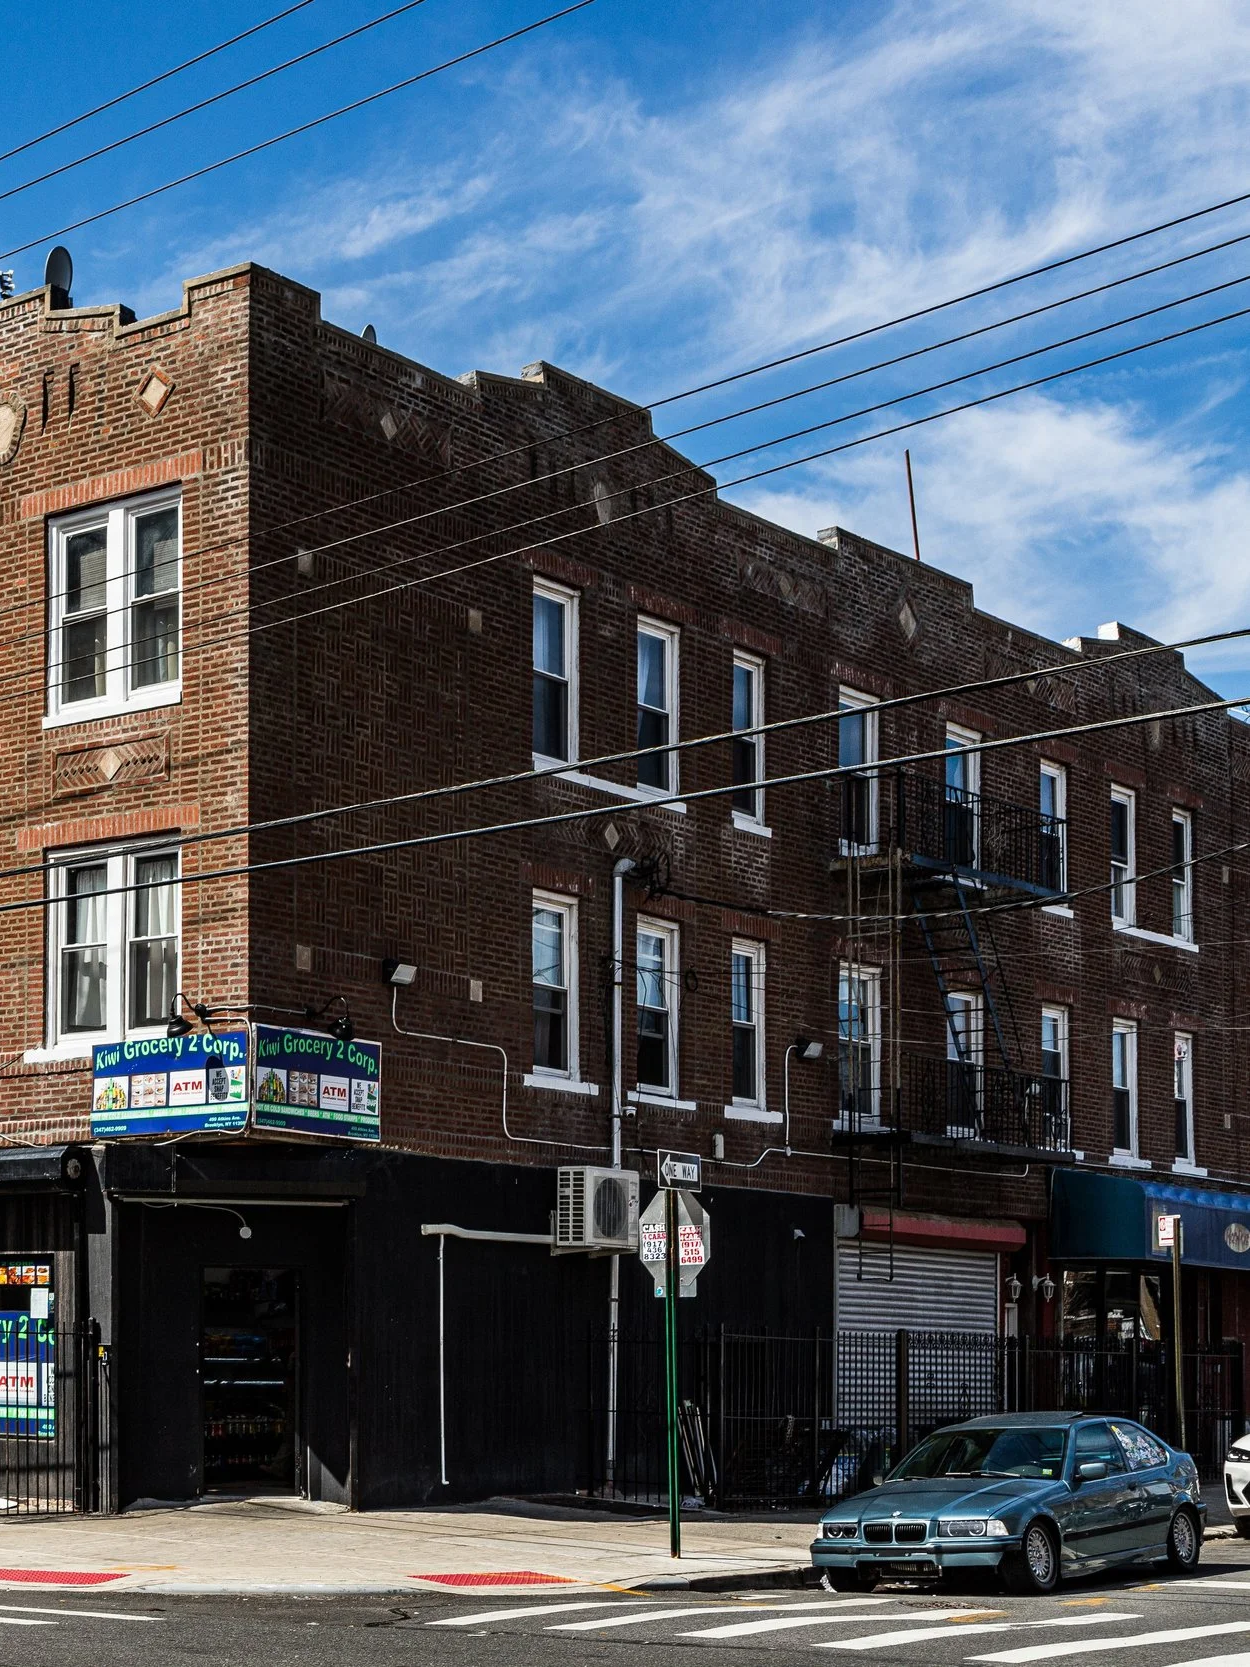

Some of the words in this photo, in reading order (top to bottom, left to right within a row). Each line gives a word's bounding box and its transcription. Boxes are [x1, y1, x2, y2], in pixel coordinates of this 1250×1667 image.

[96, 1046, 120, 1070] Kiwi
[124, 1038, 184, 1060] Grocery
[188, 1034, 198, 1052] 2
[202, 1033, 244, 1061] Corp.
[258, 1038, 280, 1058] Kiwi
[284, 1034, 333, 1060] Grocery
[336, 1040, 344, 1059] 2
[348, 1044, 378, 1075] Corp.
[174, 1081, 202, 1091] ATM
[322, 1086, 346, 1097] ATM
[665, 1162, 676, 1177] ONE
[682, 1165, 695, 1179] WAY
[643, 1224, 666, 1232] CASH
[18, 1316, 28, 1339] 2
